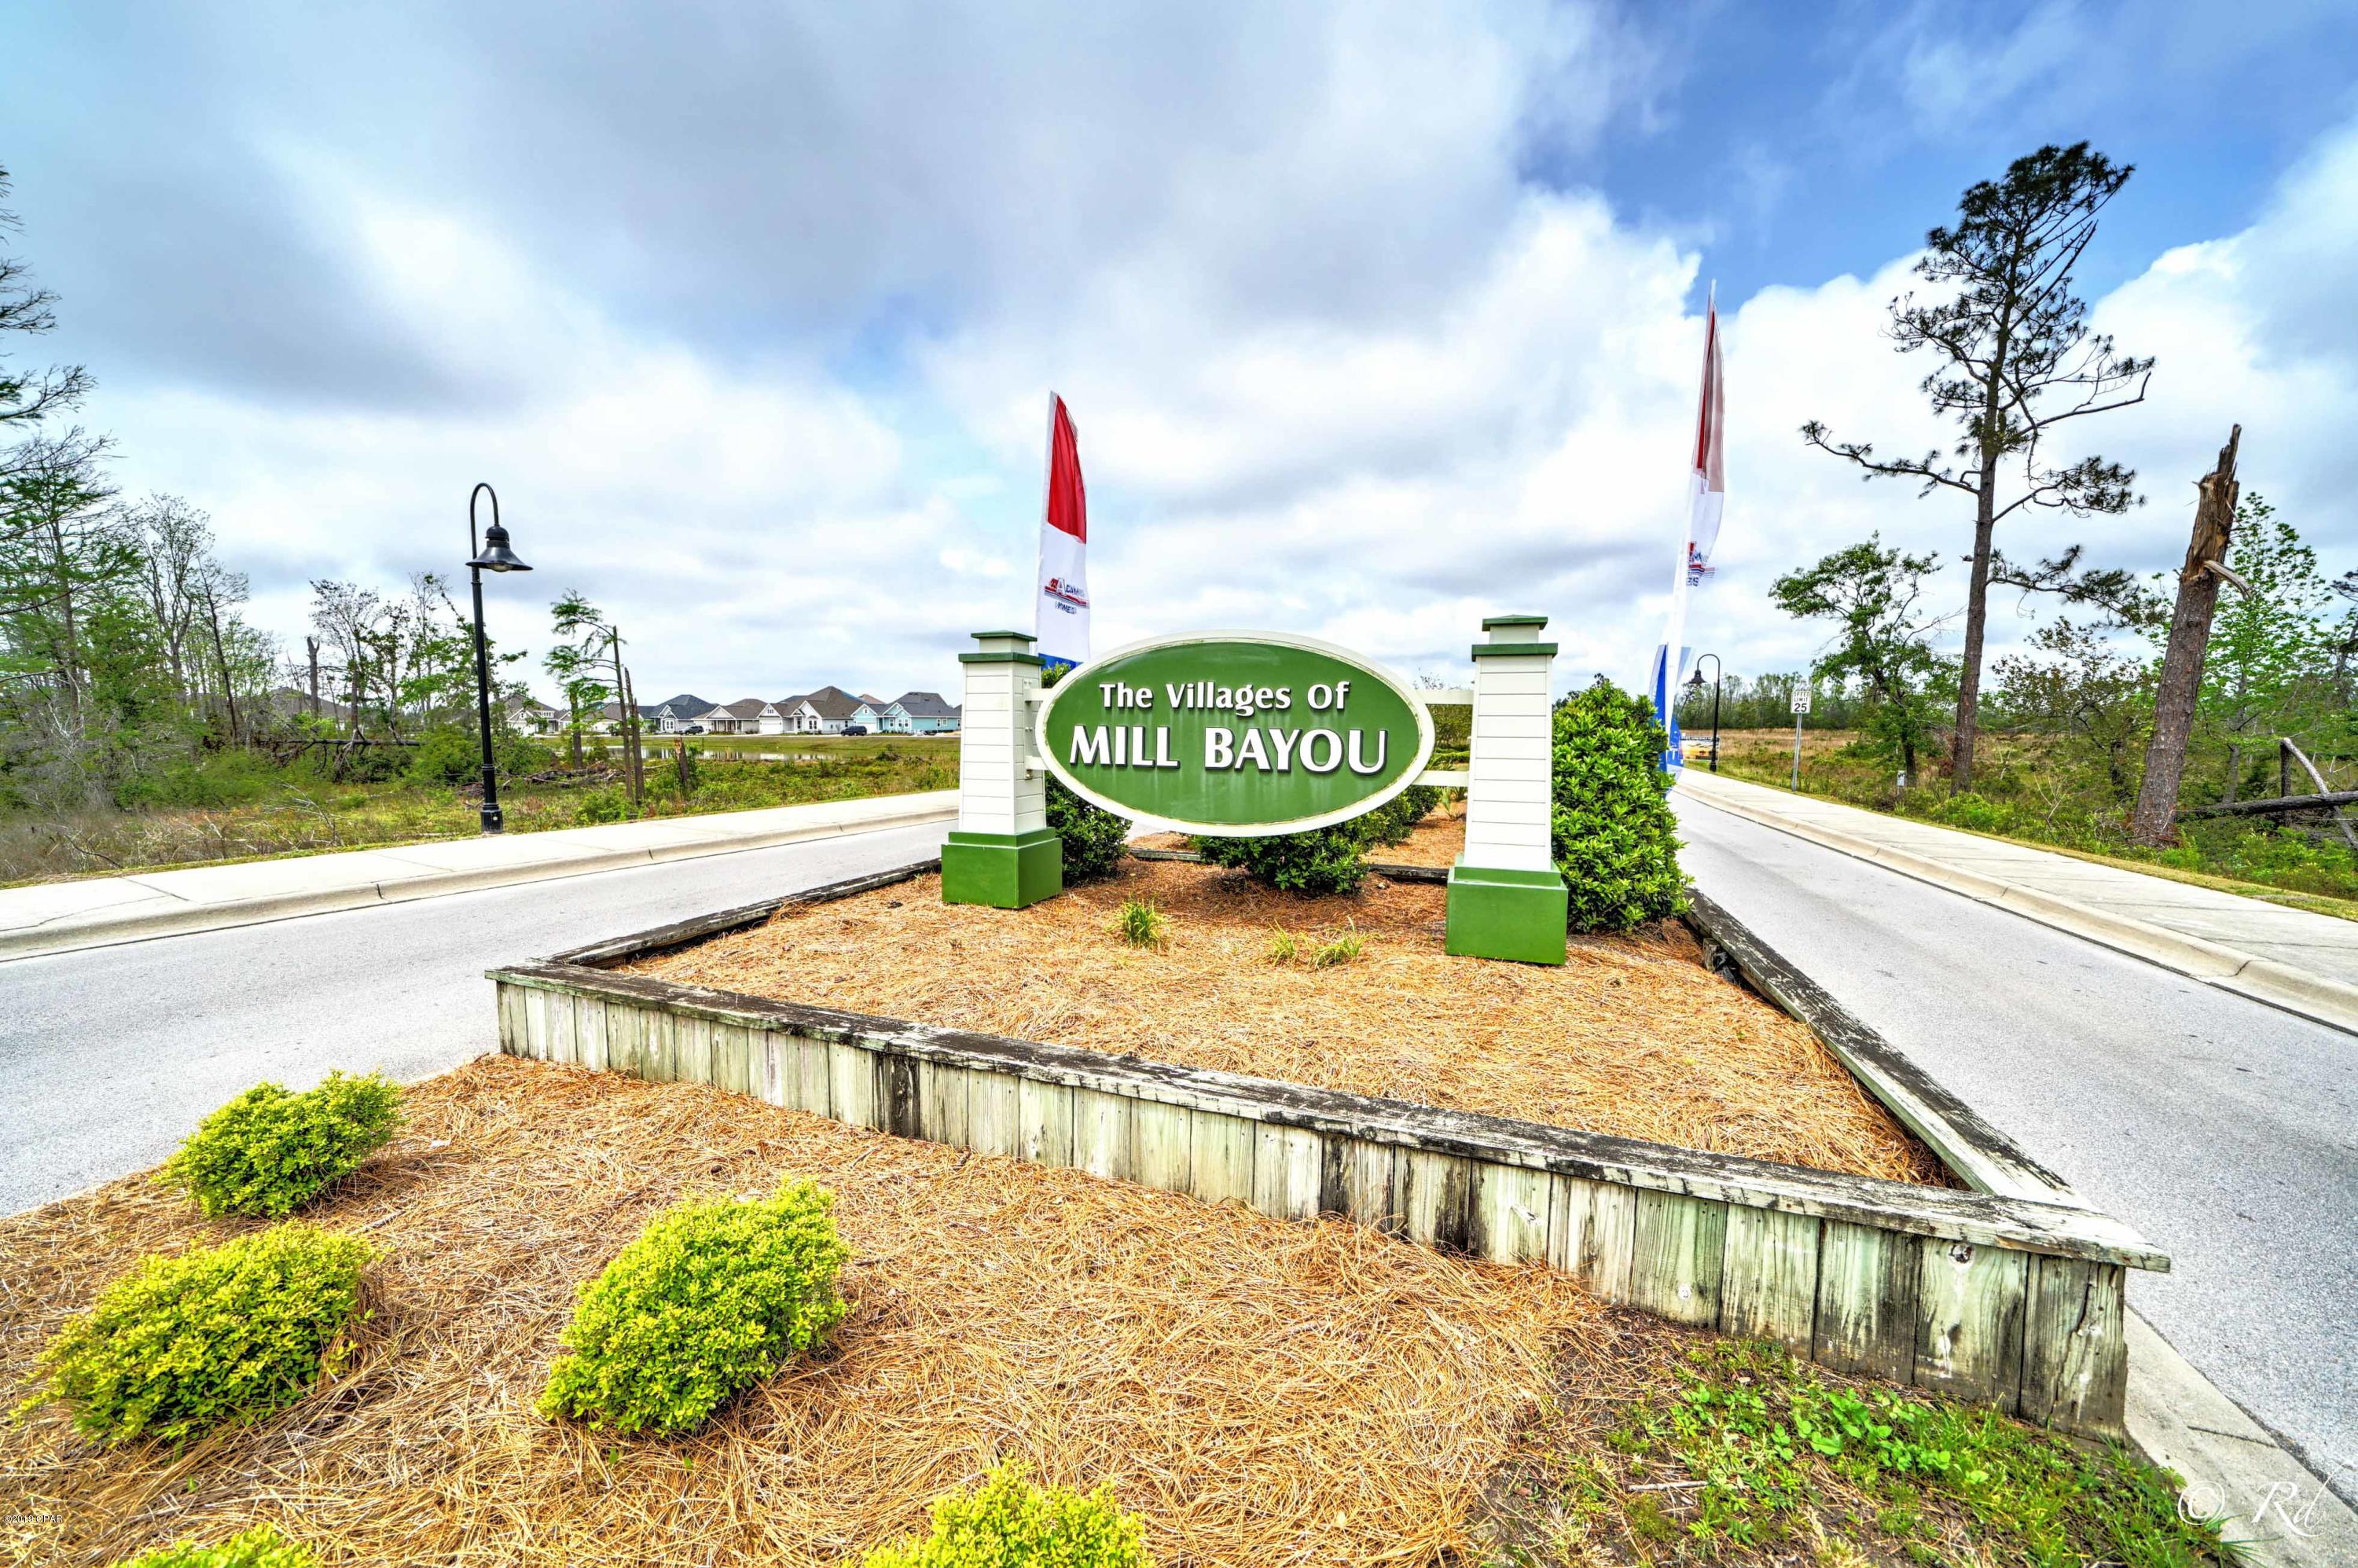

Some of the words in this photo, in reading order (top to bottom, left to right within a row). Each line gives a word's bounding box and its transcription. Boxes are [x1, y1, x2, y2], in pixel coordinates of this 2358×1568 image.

[1099, 682, 1153, 708] The
[1166, 681, 1291, 716] Villages
[1307, 681, 1351, 710] Of
[1794, 703, 1807, 712] 25
[1069, 725, 1181, 769] MILL
[1204, 726, 1389, 776] BAYOU
